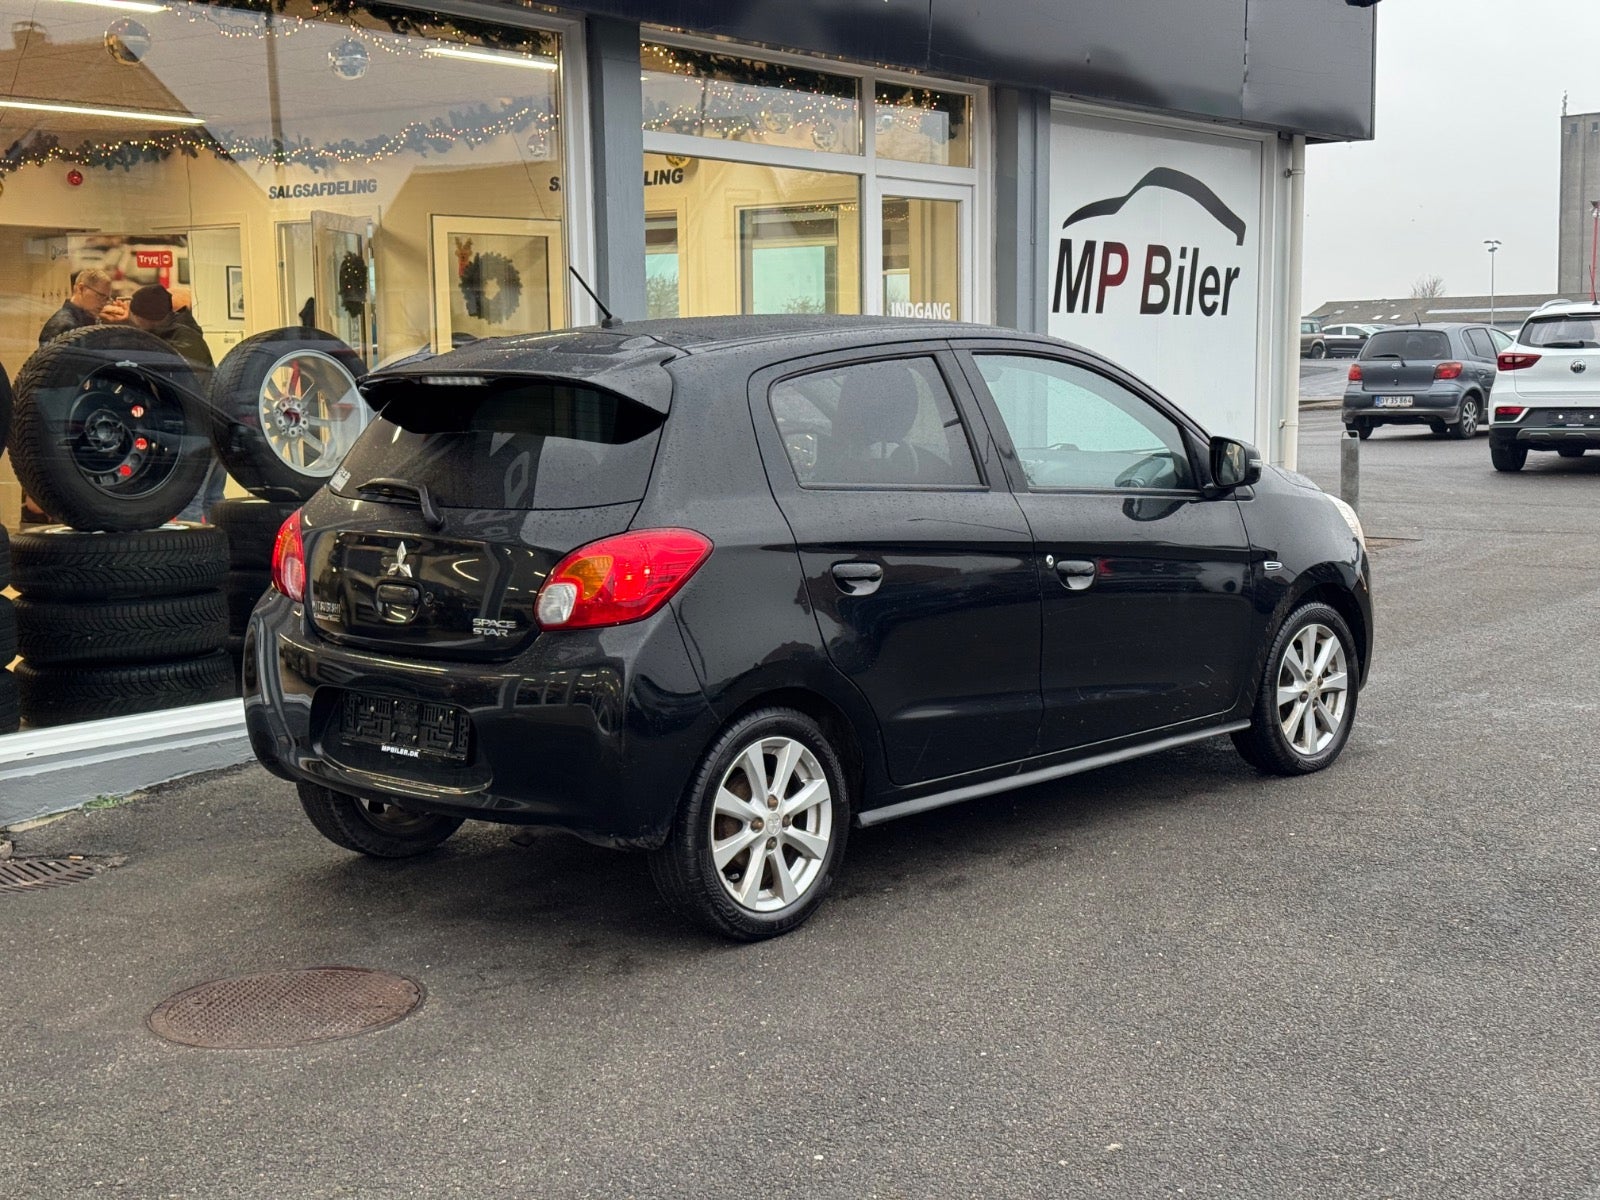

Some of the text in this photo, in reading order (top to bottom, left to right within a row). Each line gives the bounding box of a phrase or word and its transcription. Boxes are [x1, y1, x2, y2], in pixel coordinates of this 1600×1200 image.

[268, 179, 377, 199] SALGSAFDELING
[138, 254, 159, 265] Tryg
[1052, 238, 1240, 317] MP Biler
[891, 302, 951, 320] INDGANG
[473, 618, 517, 629] SPACE
[473, 627, 509, 638] STAR
